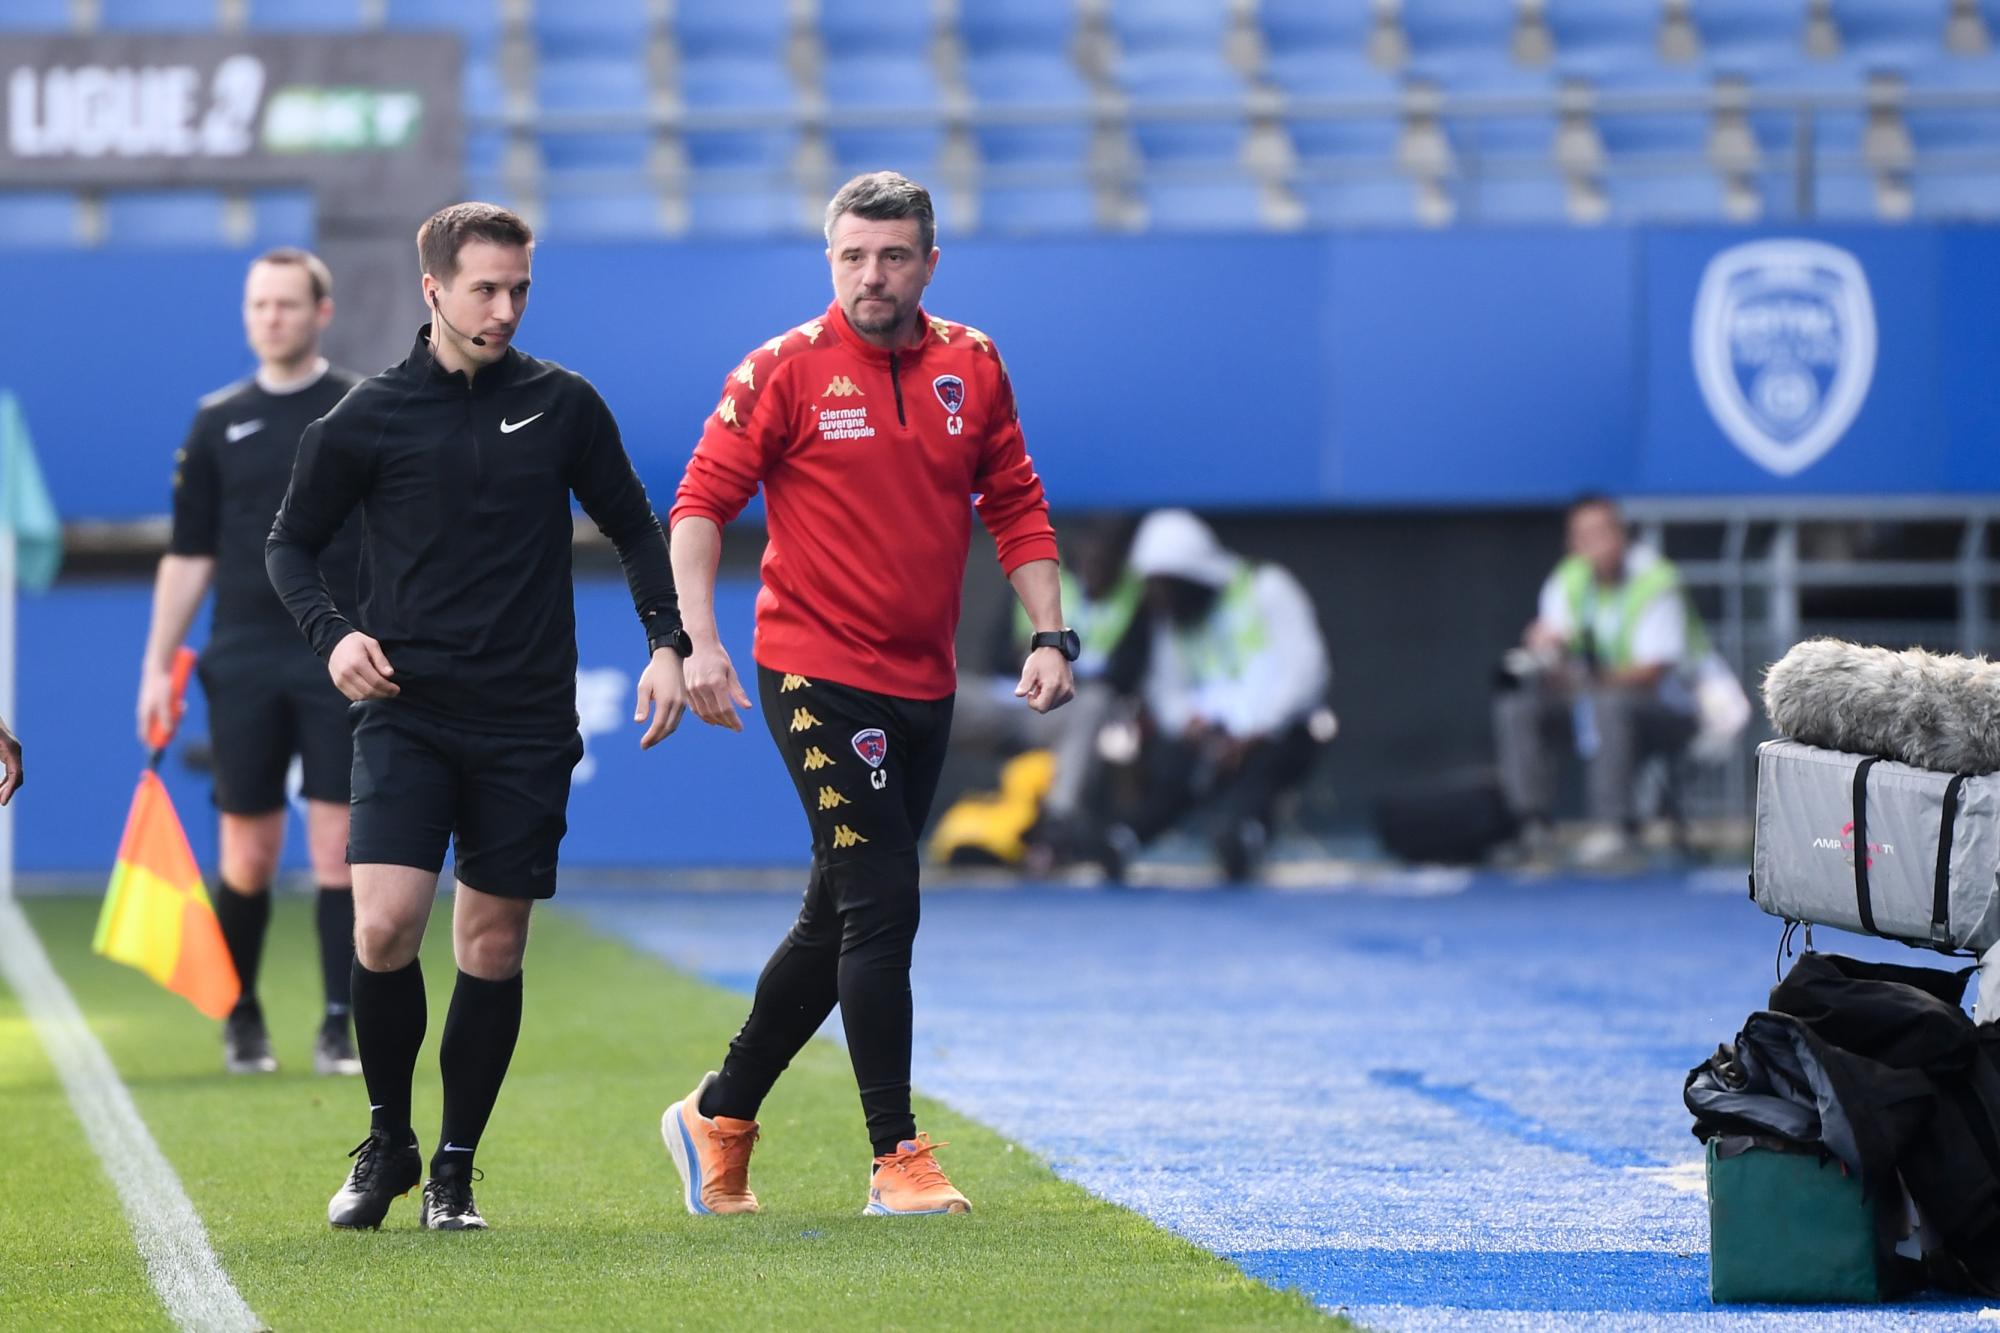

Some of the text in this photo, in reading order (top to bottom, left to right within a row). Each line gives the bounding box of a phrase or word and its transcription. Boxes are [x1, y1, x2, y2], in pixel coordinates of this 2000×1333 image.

[7, 65, 199, 158] LIGUE
[198, 53, 266, 158] 2
[820, 407, 867, 420] clermont
[818, 418, 866, 431] auvergne
[823, 426, 875, 440] métropole
